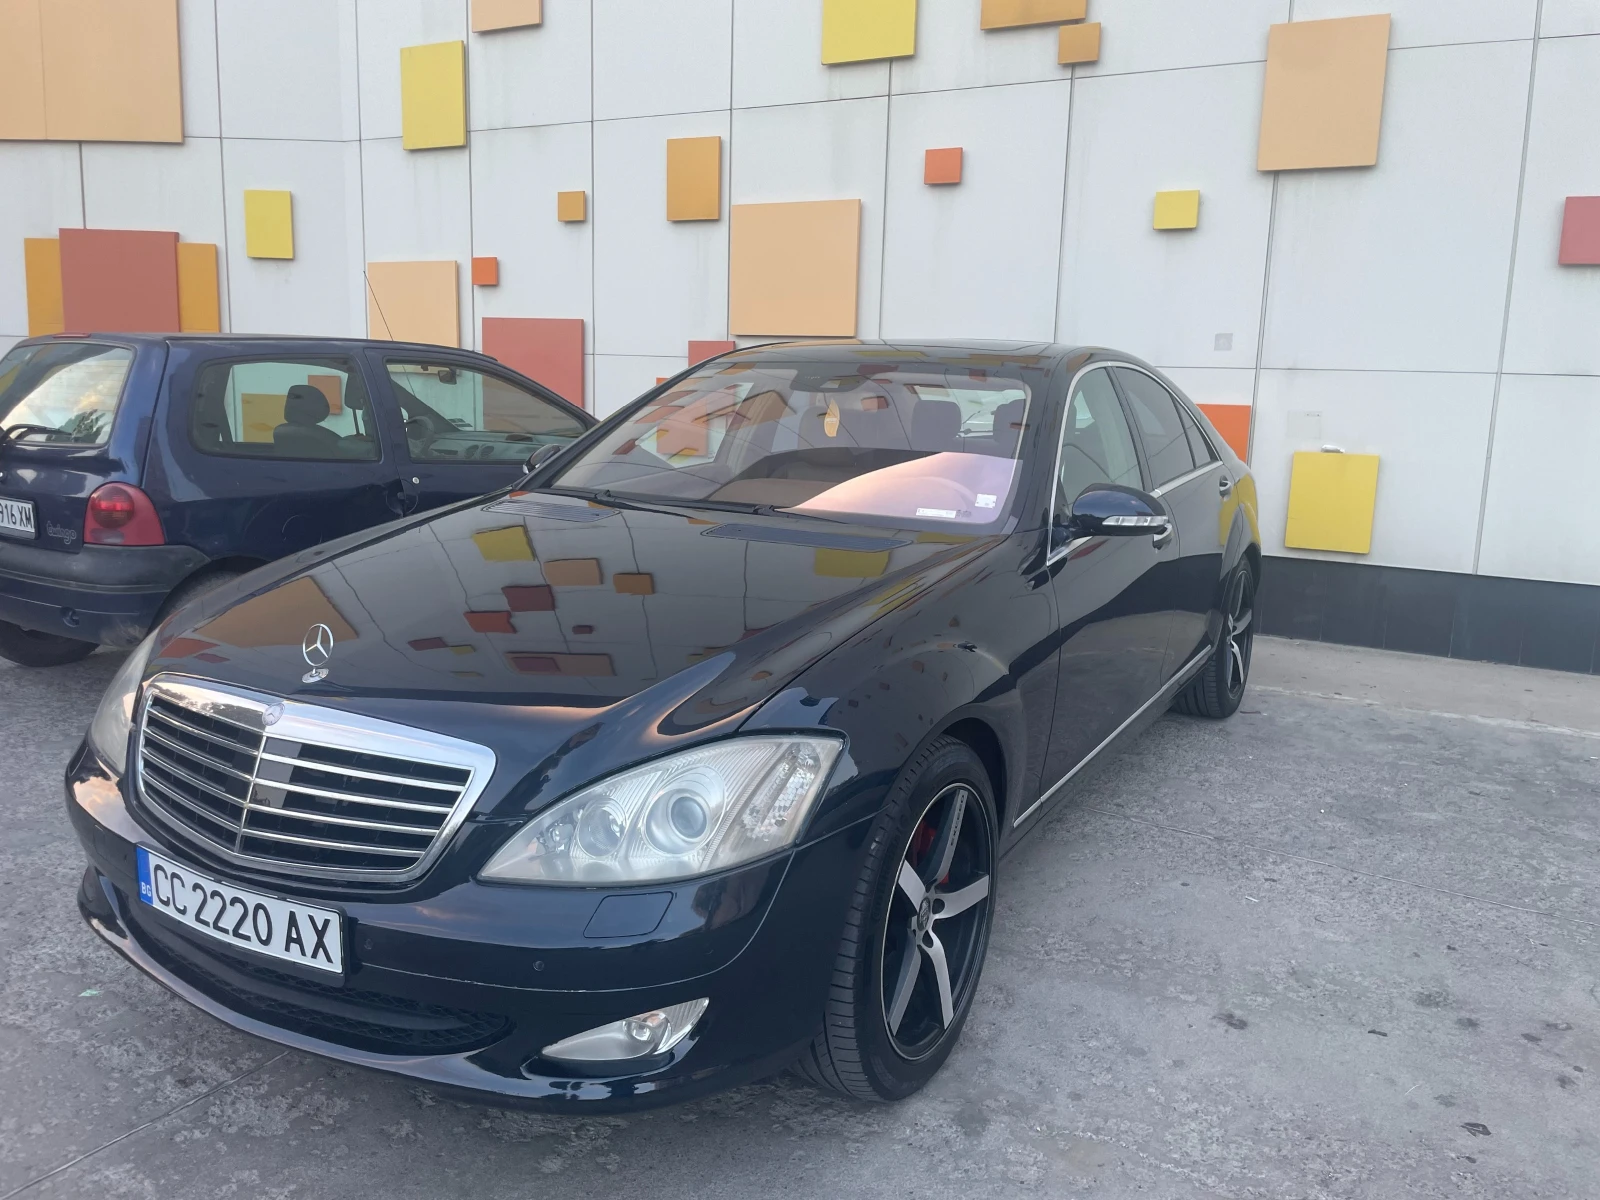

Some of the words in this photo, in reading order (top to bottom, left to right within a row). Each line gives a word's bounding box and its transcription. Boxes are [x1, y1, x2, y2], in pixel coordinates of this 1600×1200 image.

[17, 505, 33, 529] XM
[141, 881, 152, 897] BG
[153, 863, 188, 916] CC
[191, 882, 273, 947] 2220
[284, 909, 334, 964] AX
